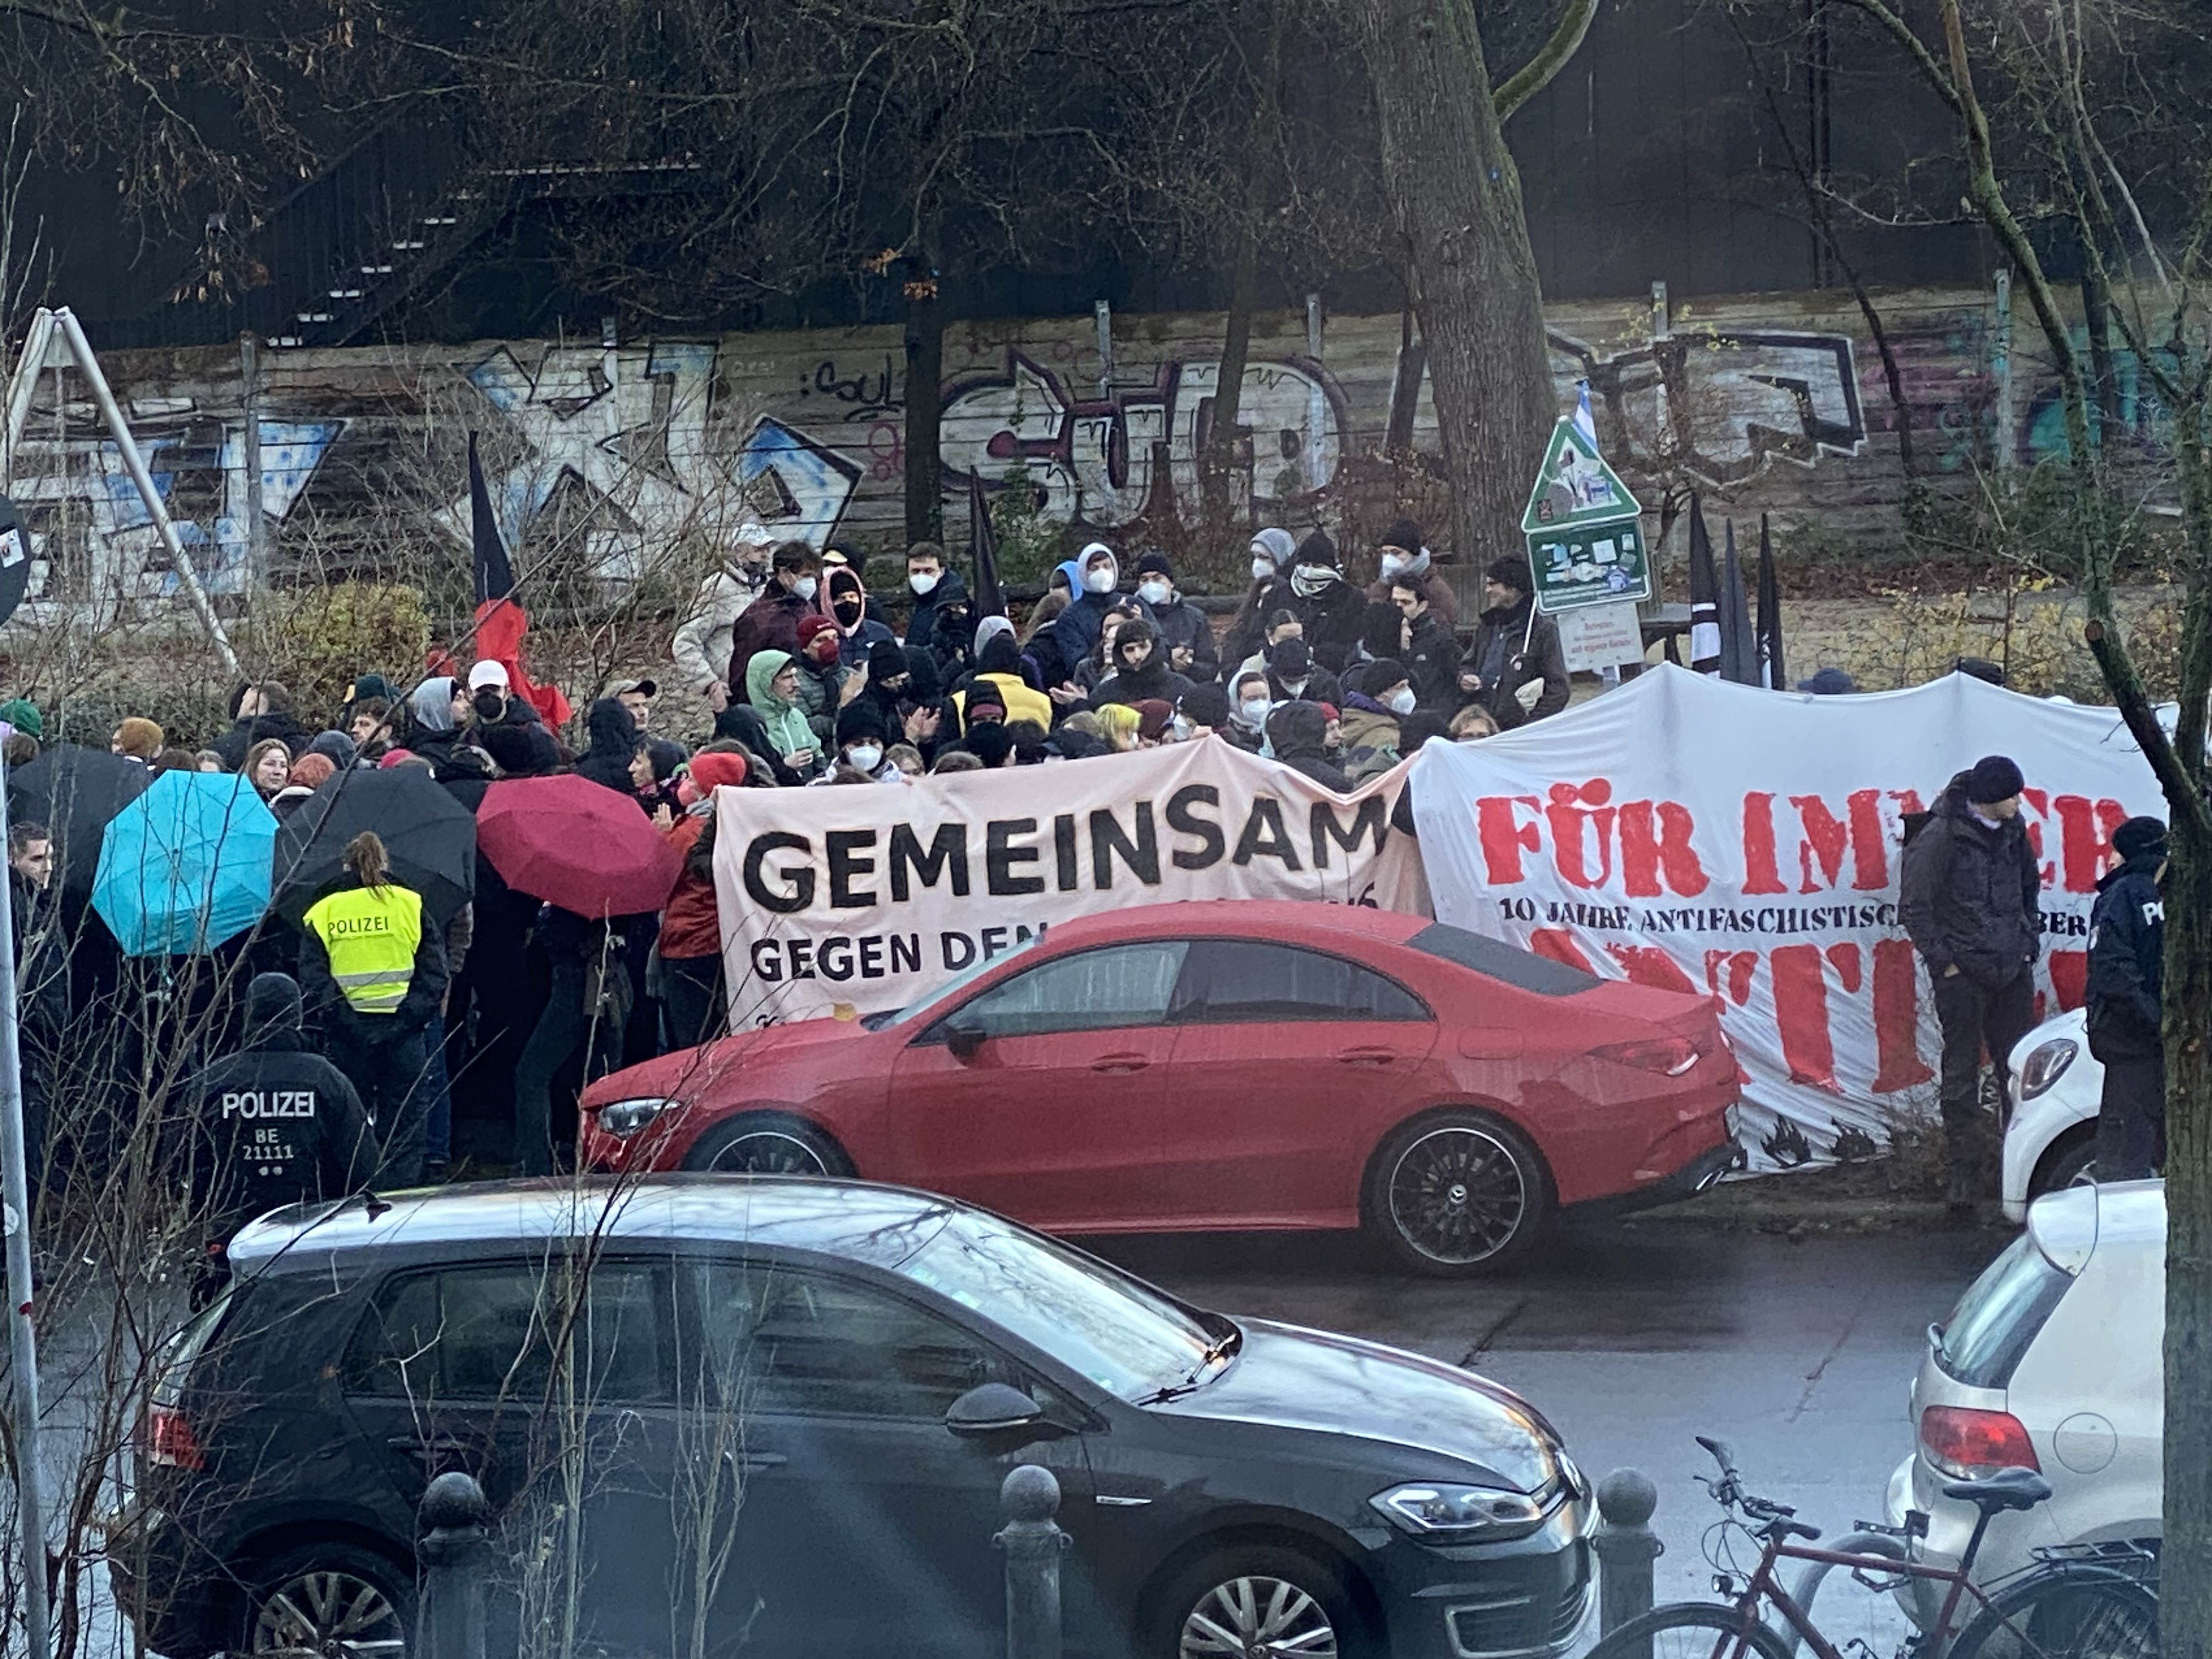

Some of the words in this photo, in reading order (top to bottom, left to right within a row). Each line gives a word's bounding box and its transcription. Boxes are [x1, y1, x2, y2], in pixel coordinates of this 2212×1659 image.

[743, 784, 1387, 913] GEMEINSAM
[1476, 777, 1710, 898] FÜR
[328, 916, 388, 934] POLIZEI
[1500, 898, 1536, 921] 10
[1547, 901, 1630, 931] JAHRE
[1641, 904, 1895, 933] ANTIFASCHISTISC
[751, 933, 921, 981] GEGEN
[222, 1091, 315, 1119] POLIZEI
[255, 1128, 279, 1144] BE
[242, 1144, 295, 1160] 21111
